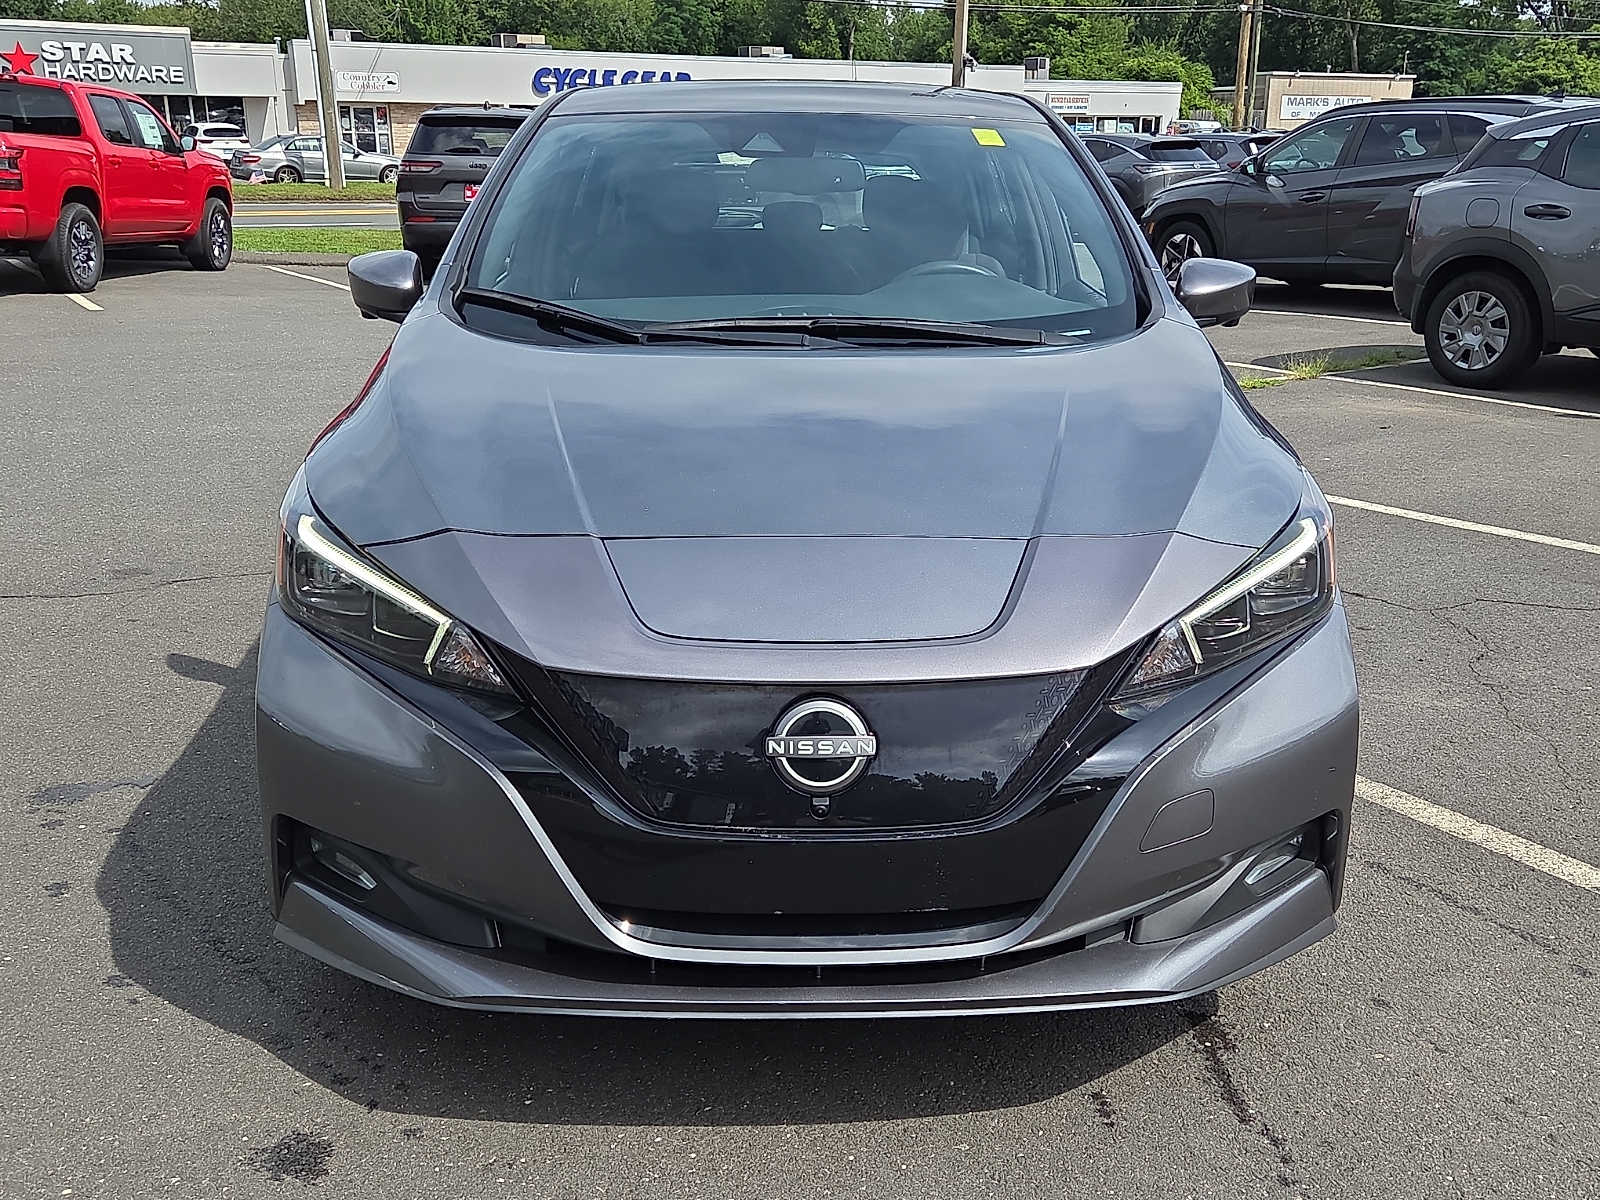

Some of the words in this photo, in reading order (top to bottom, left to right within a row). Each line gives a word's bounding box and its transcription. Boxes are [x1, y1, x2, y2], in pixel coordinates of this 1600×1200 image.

[41, 40, 136, 64] STAR
[43, 62, 185, 83] HARDWARE
[342, 73, 381, 82] Country
[532, 67, 617, 96] CYCLE
[1286, 97, 1329, 107] MARK'S
[768, 740, 875, 755] NISSAN
